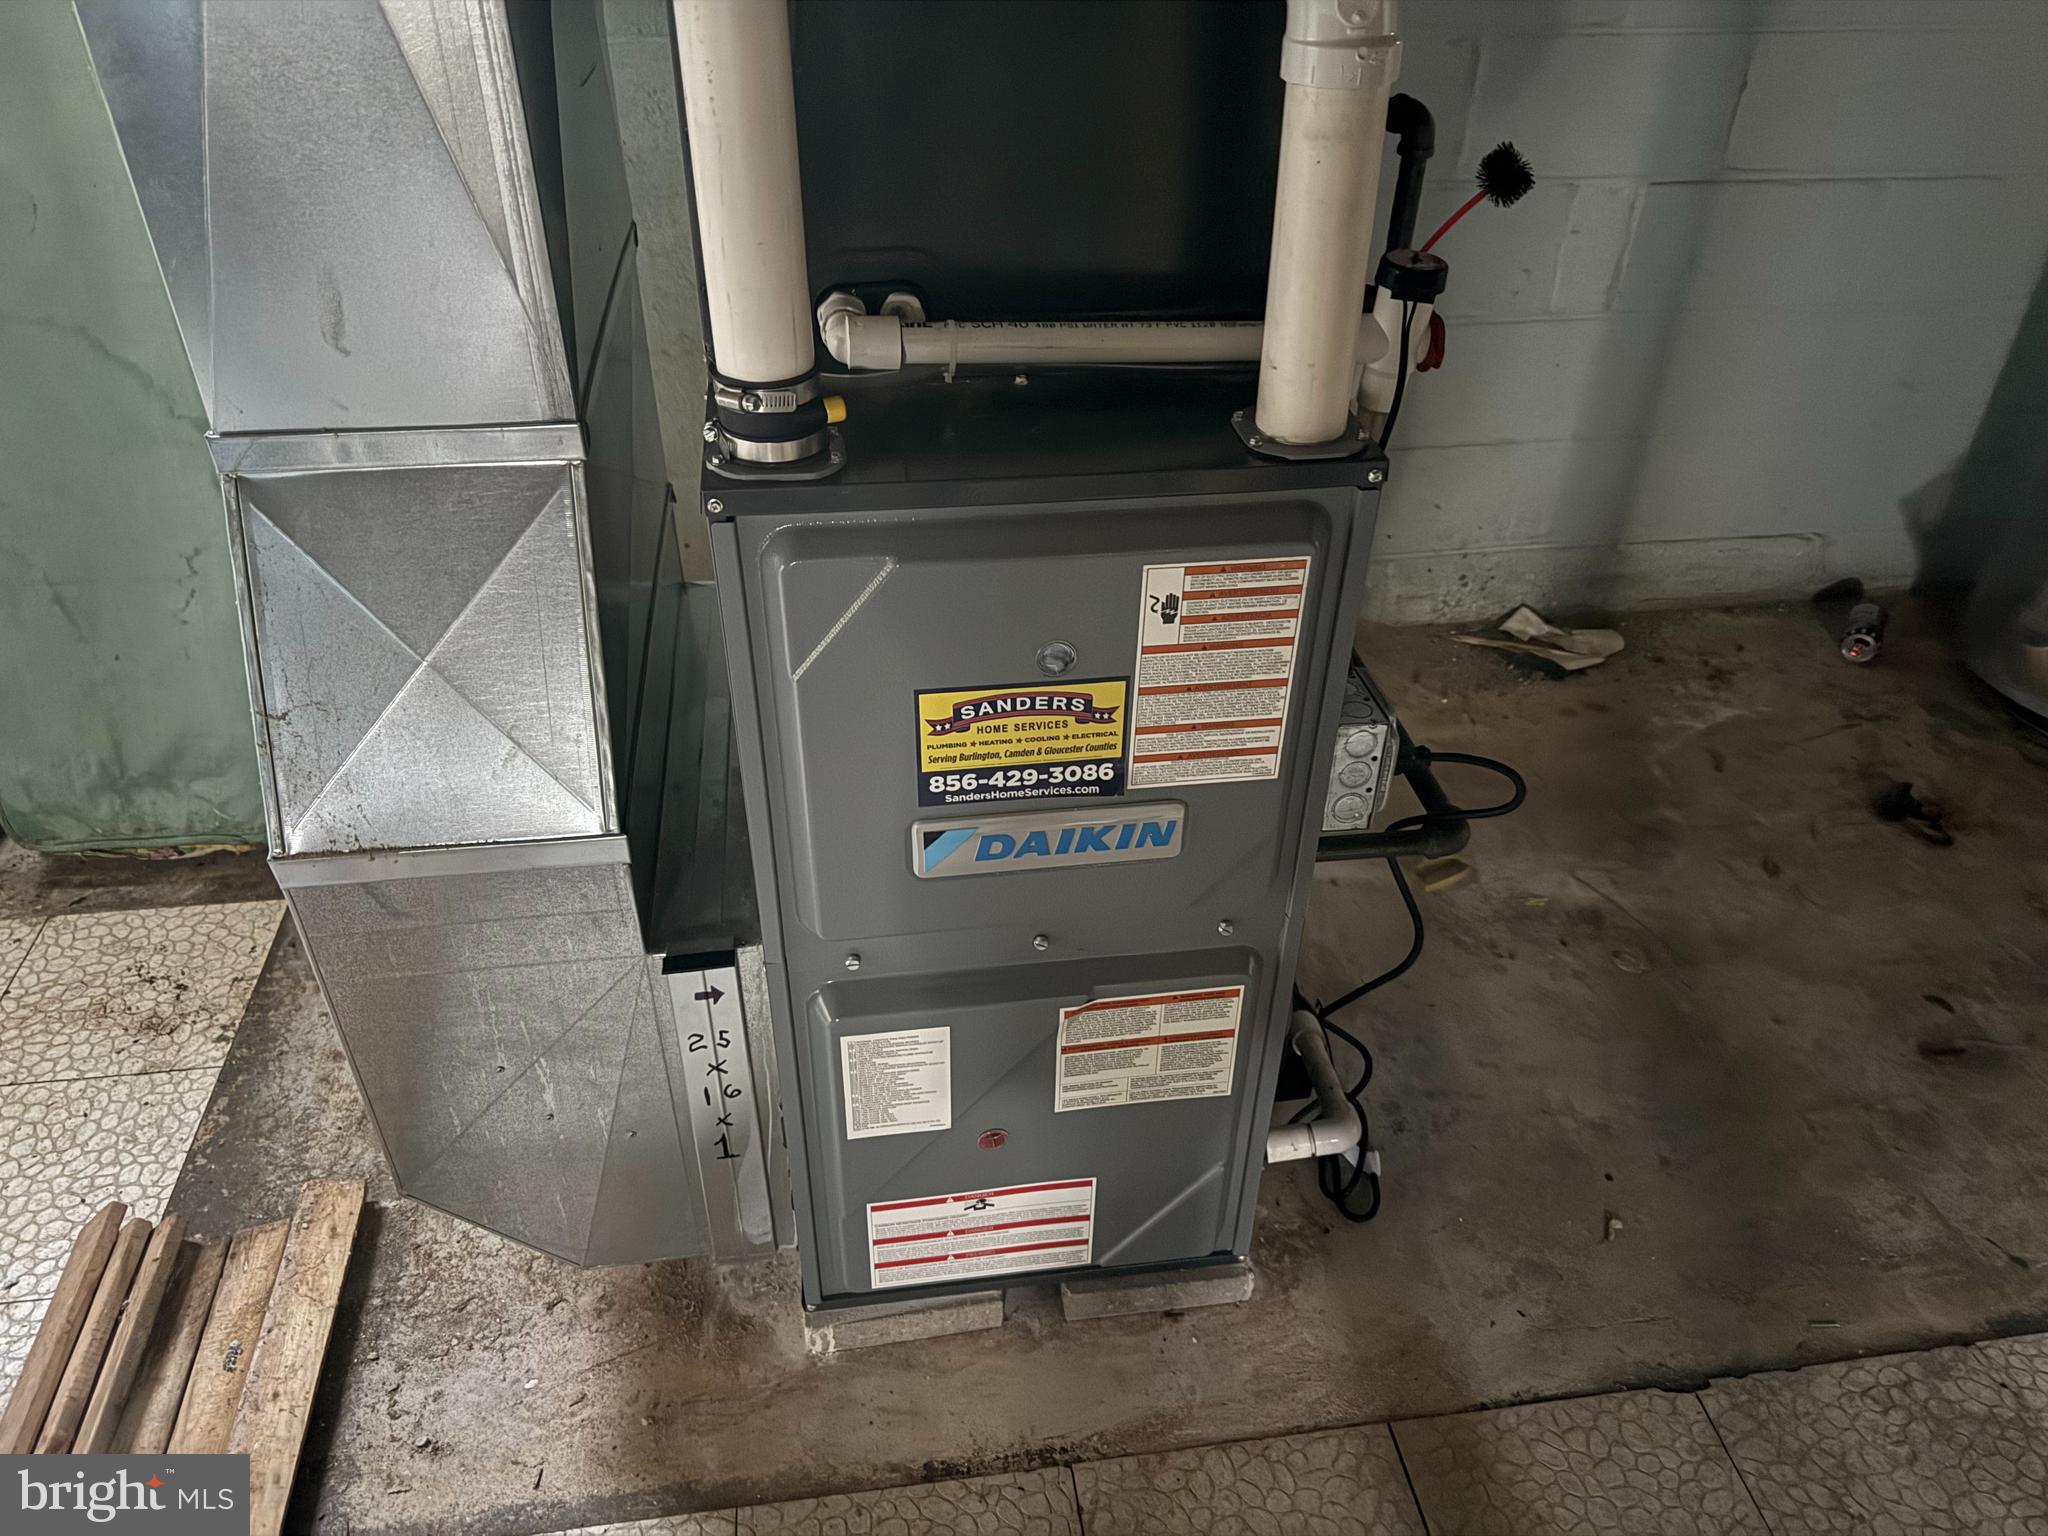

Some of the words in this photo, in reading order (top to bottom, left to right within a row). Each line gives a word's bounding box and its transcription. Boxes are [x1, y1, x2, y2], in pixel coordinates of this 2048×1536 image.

[960, 696, 1085, 720] SANDERS
[976, 723, 1009, 735] HOME
[1013, 719, 1069, 732] SERVICES
[926, 740, 968, 751] PLUMBING
[978, 737, 1014, 747] HEATING
[1024, 734, 1061, 743] COOLING
[1071, 730, 1119, 740] ELECTRICAL
[927, 753, 958, 765] Serving
[958, 750, 1003, 763] Burlington,
[1004, 747, 1035, 759] Camden
[1036, 746, 1043, 756] &
[1043, 743, 1084, 755] Gloucester
[1085, 741, 1118, 752] Counties
[928, 763, 1115, 793] 856-429-3086
[944, 785, 1100, 803] SandersHomeServices.com
[975, 820, 1178, 862] DAIKIN
[713, 1133, 741, 1160] 1
